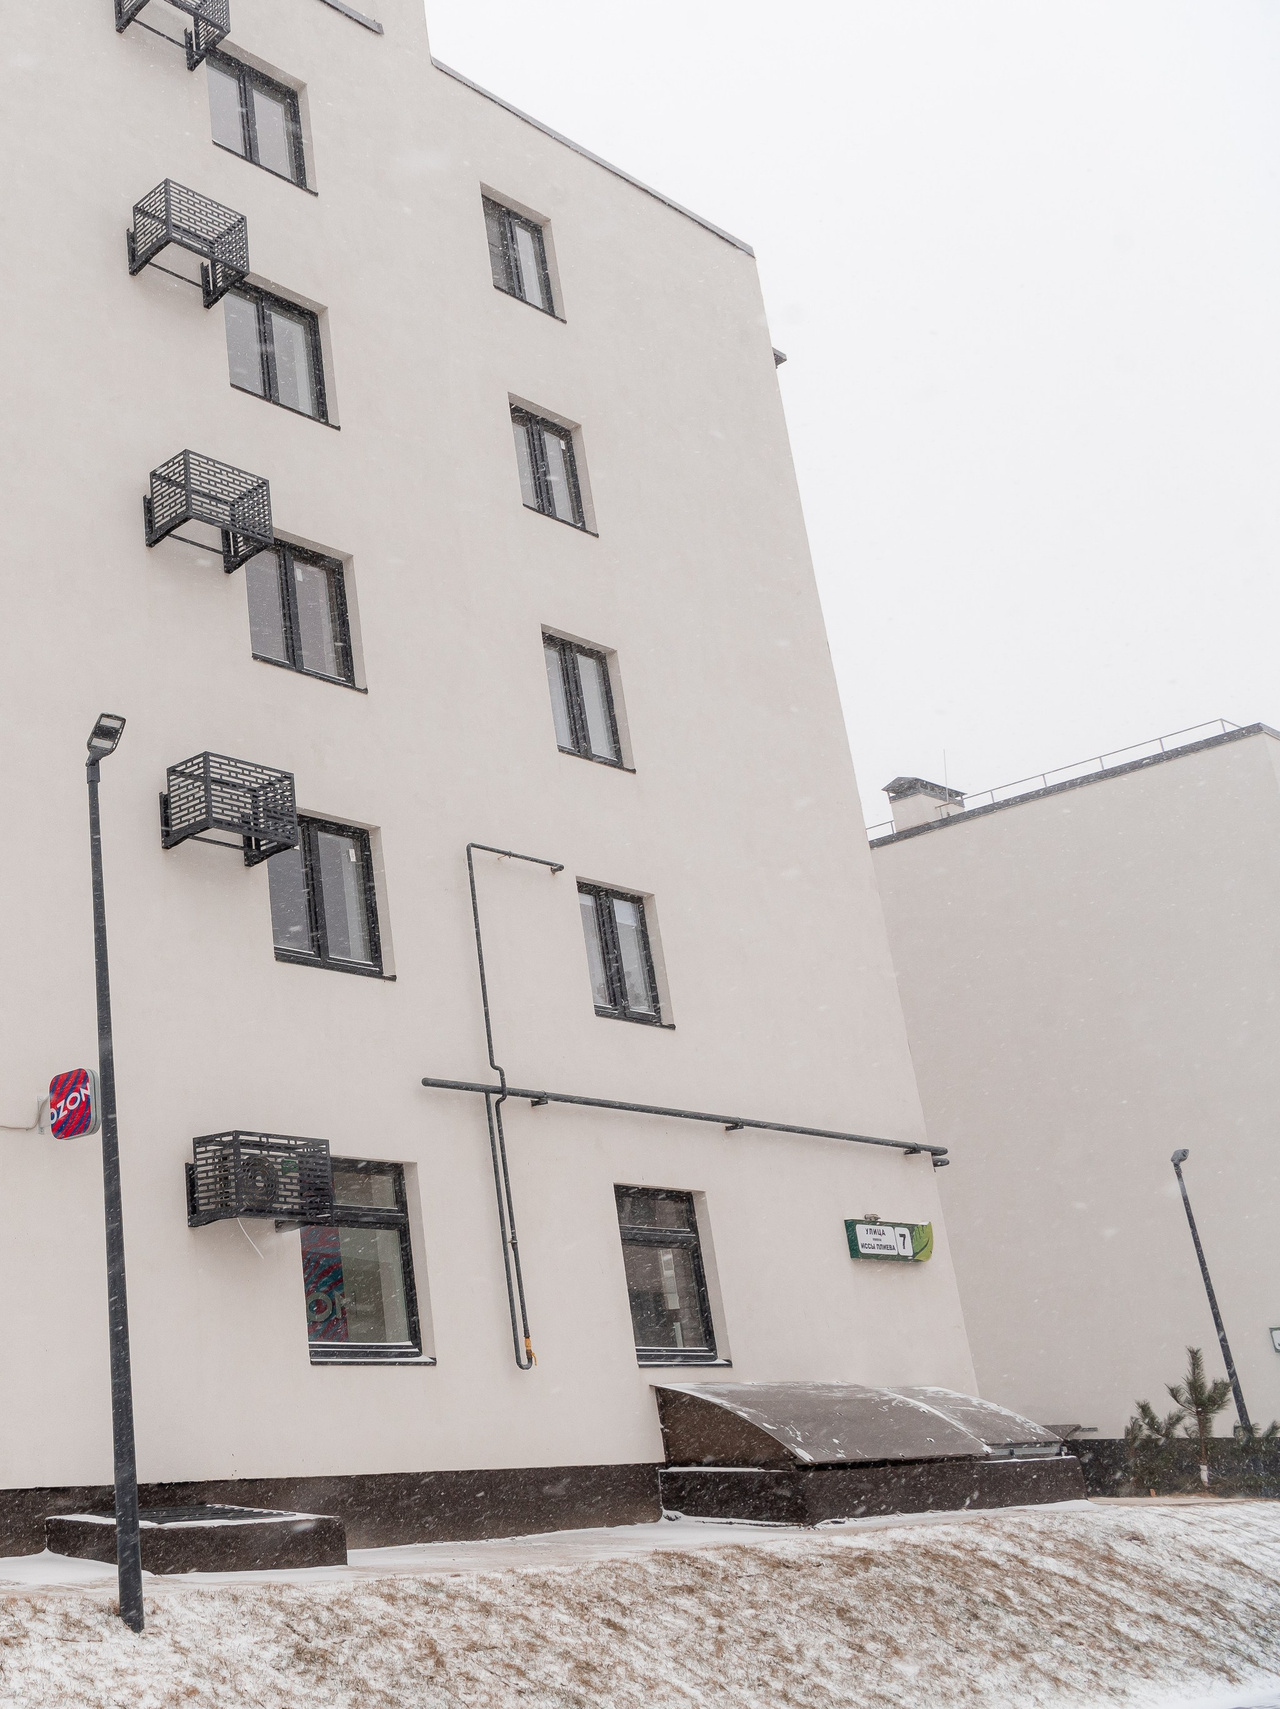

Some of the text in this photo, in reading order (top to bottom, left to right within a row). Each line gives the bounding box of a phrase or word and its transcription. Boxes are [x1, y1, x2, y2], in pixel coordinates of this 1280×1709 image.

[51, 1083, 90, 1125] OZON
[865, 1228, 886, 1236] УЛИЦА
[899, 1234, 906, 1249] 7
